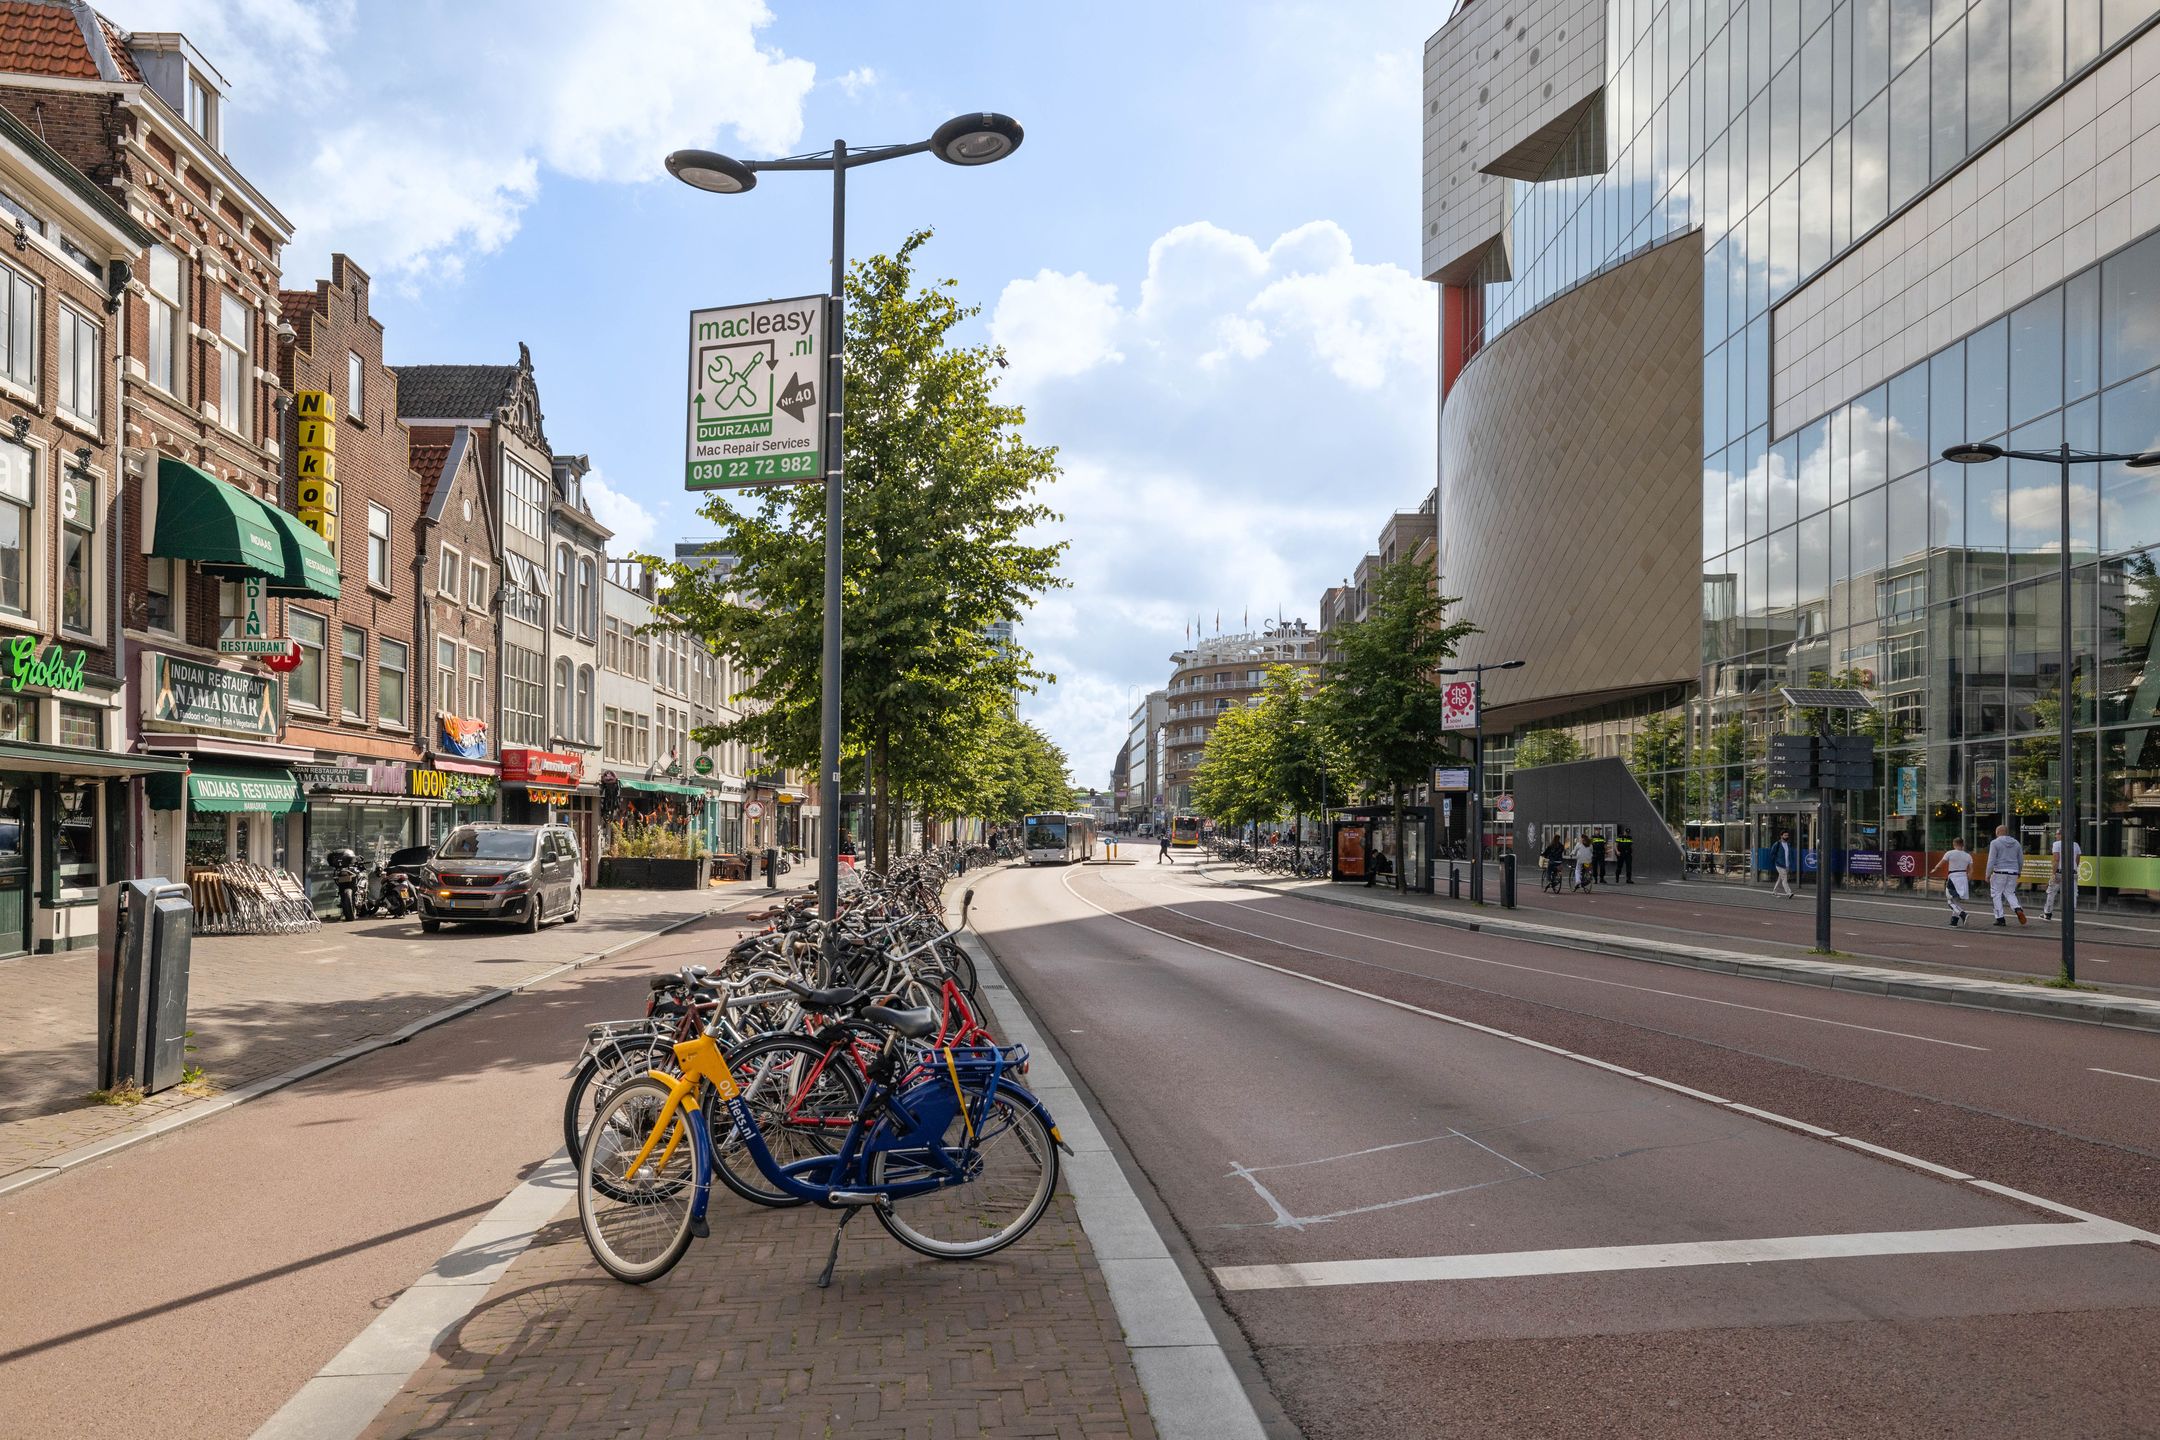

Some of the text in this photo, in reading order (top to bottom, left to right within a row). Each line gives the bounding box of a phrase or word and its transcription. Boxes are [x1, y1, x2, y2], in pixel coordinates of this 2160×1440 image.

[698, 309, 816, 341] macleasy
[789, 334, 813, 356] .nl
[781, 388, 812, 407] Nr. 40
[699, 422, 770, 438] DUURZAAM
[696, 437, 810, 457] Mac Repair Services
[302, 395, 321, 533] Nikon
[325, 398, 334, 537] Nikon
[693, 456, 812, 480] 030 22 72 982
[250, 534, 272, 551] INDIAAS
[305, 557, 335, 577] RESTAURANT
[246, 577, 260, 635] NDIAN
[221, 641, 286, 652] RESTAURANT
[11, 635, 86, 693] Grolsch
[171, 664, 265, 696] INDIAN RESTAURANT
[175, 684, 259, 717] NAMASKAR
[1451, 685, 1467, 698] cha
[1451, 696, 1468, 706] cha
[204, 714, 217, 725] Curry
[222, 716, 233, 726] Fish
[236, 718, 258, 730] Vegetarian
[295, 773, 350, 784] AMASKAR
[412, 768, 447, 797] MOON
[197, 780, 301, 799] INDIAAS RESTAURANT
[243, 802, 267, 810] NAMASKAR
[719, 1080, 757, 1140] OV-fiets.nl
